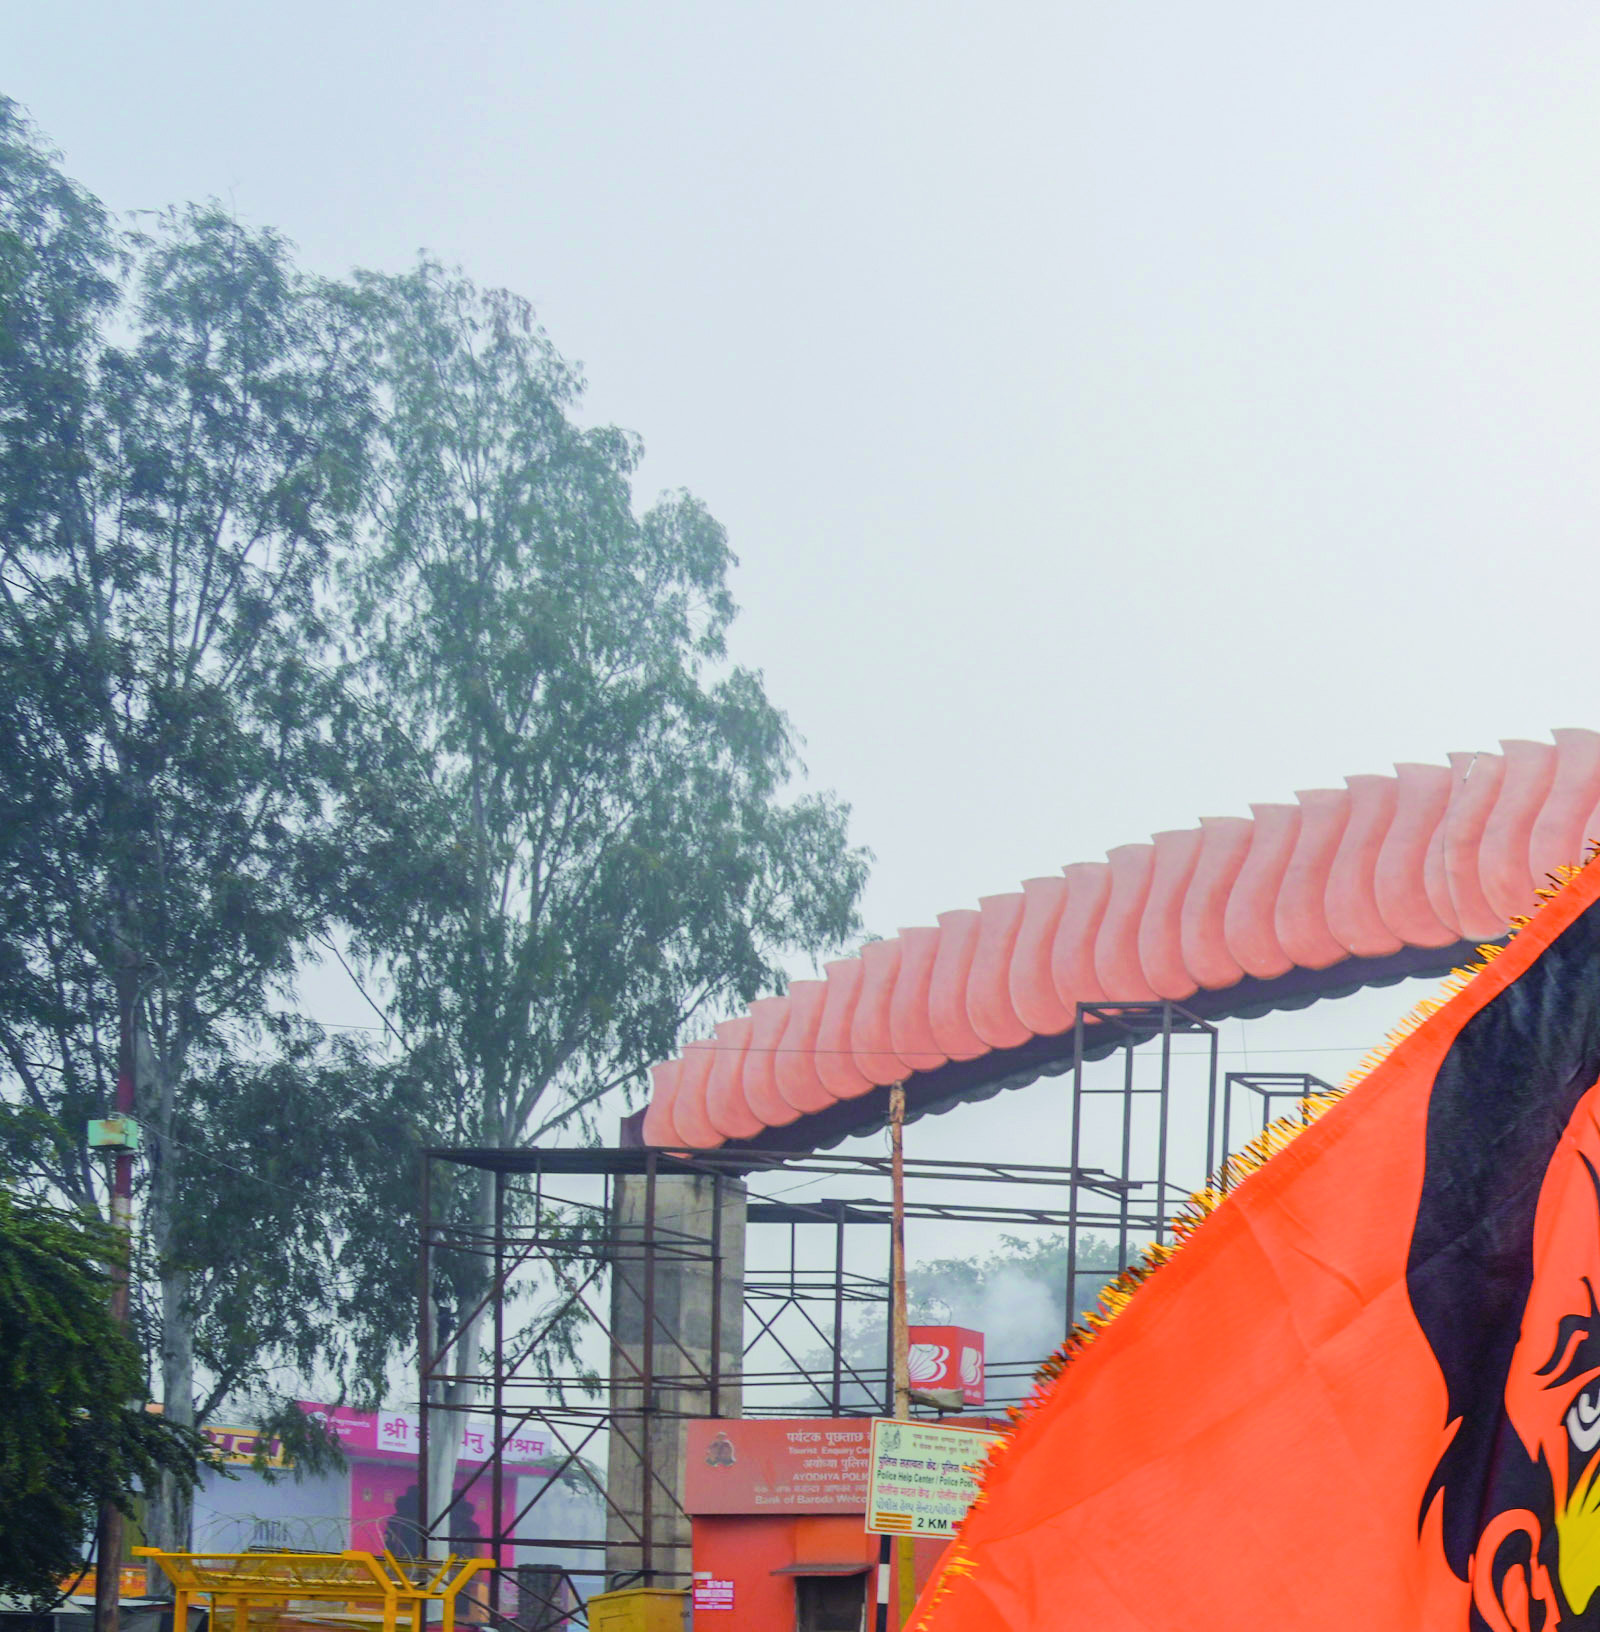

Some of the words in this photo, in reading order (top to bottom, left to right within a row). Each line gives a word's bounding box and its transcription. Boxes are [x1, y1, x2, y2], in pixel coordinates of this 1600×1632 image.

[383, 1418, 408, 1440] श्री
[786, 1429, 822, 1443] पर्यटक
[825, 1431, 864, 1446] पूछताछ
[792, 1472, 840, 1481] AYODHYA
[877, 1470, 897, 1481] Police
[898, 1471, 912, 1482] Help
[914, 1473, 935, 1484] Center
[940, 1476, 958, 1487] Police
[960, 1478, 974, 1488] Post
[755, 1495, 781, 1505] Bank
[784, 1495, 796, 1505] of
[796, 1495, 834, 1505] Baroda
[836, 1494, 867, 1504] Welco
[917, 1517, 924, 1528] 2
[928, 1518, 947, 1529] KM
